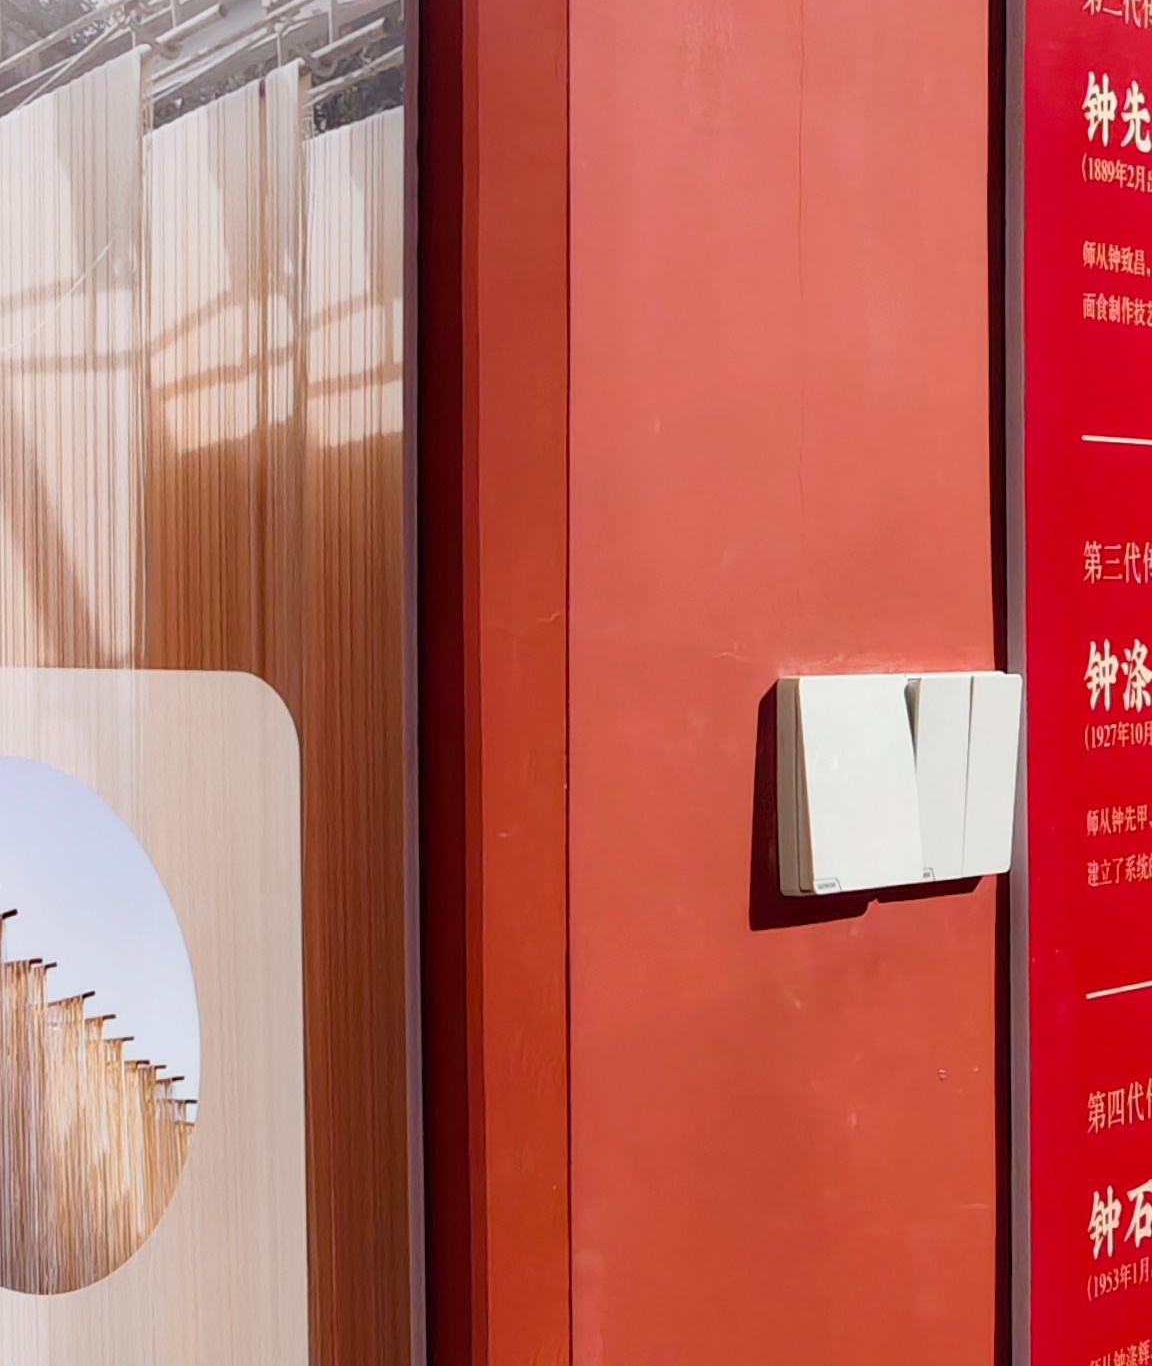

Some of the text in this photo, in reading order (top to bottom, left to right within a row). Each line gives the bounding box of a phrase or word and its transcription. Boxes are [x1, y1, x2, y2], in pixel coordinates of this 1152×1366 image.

[1082, 70, 1152, 154] 钟先
[1086, 1179, 1152, 1260] 钟石
[1086, 1256, 1152, 1302] (1953年1月
